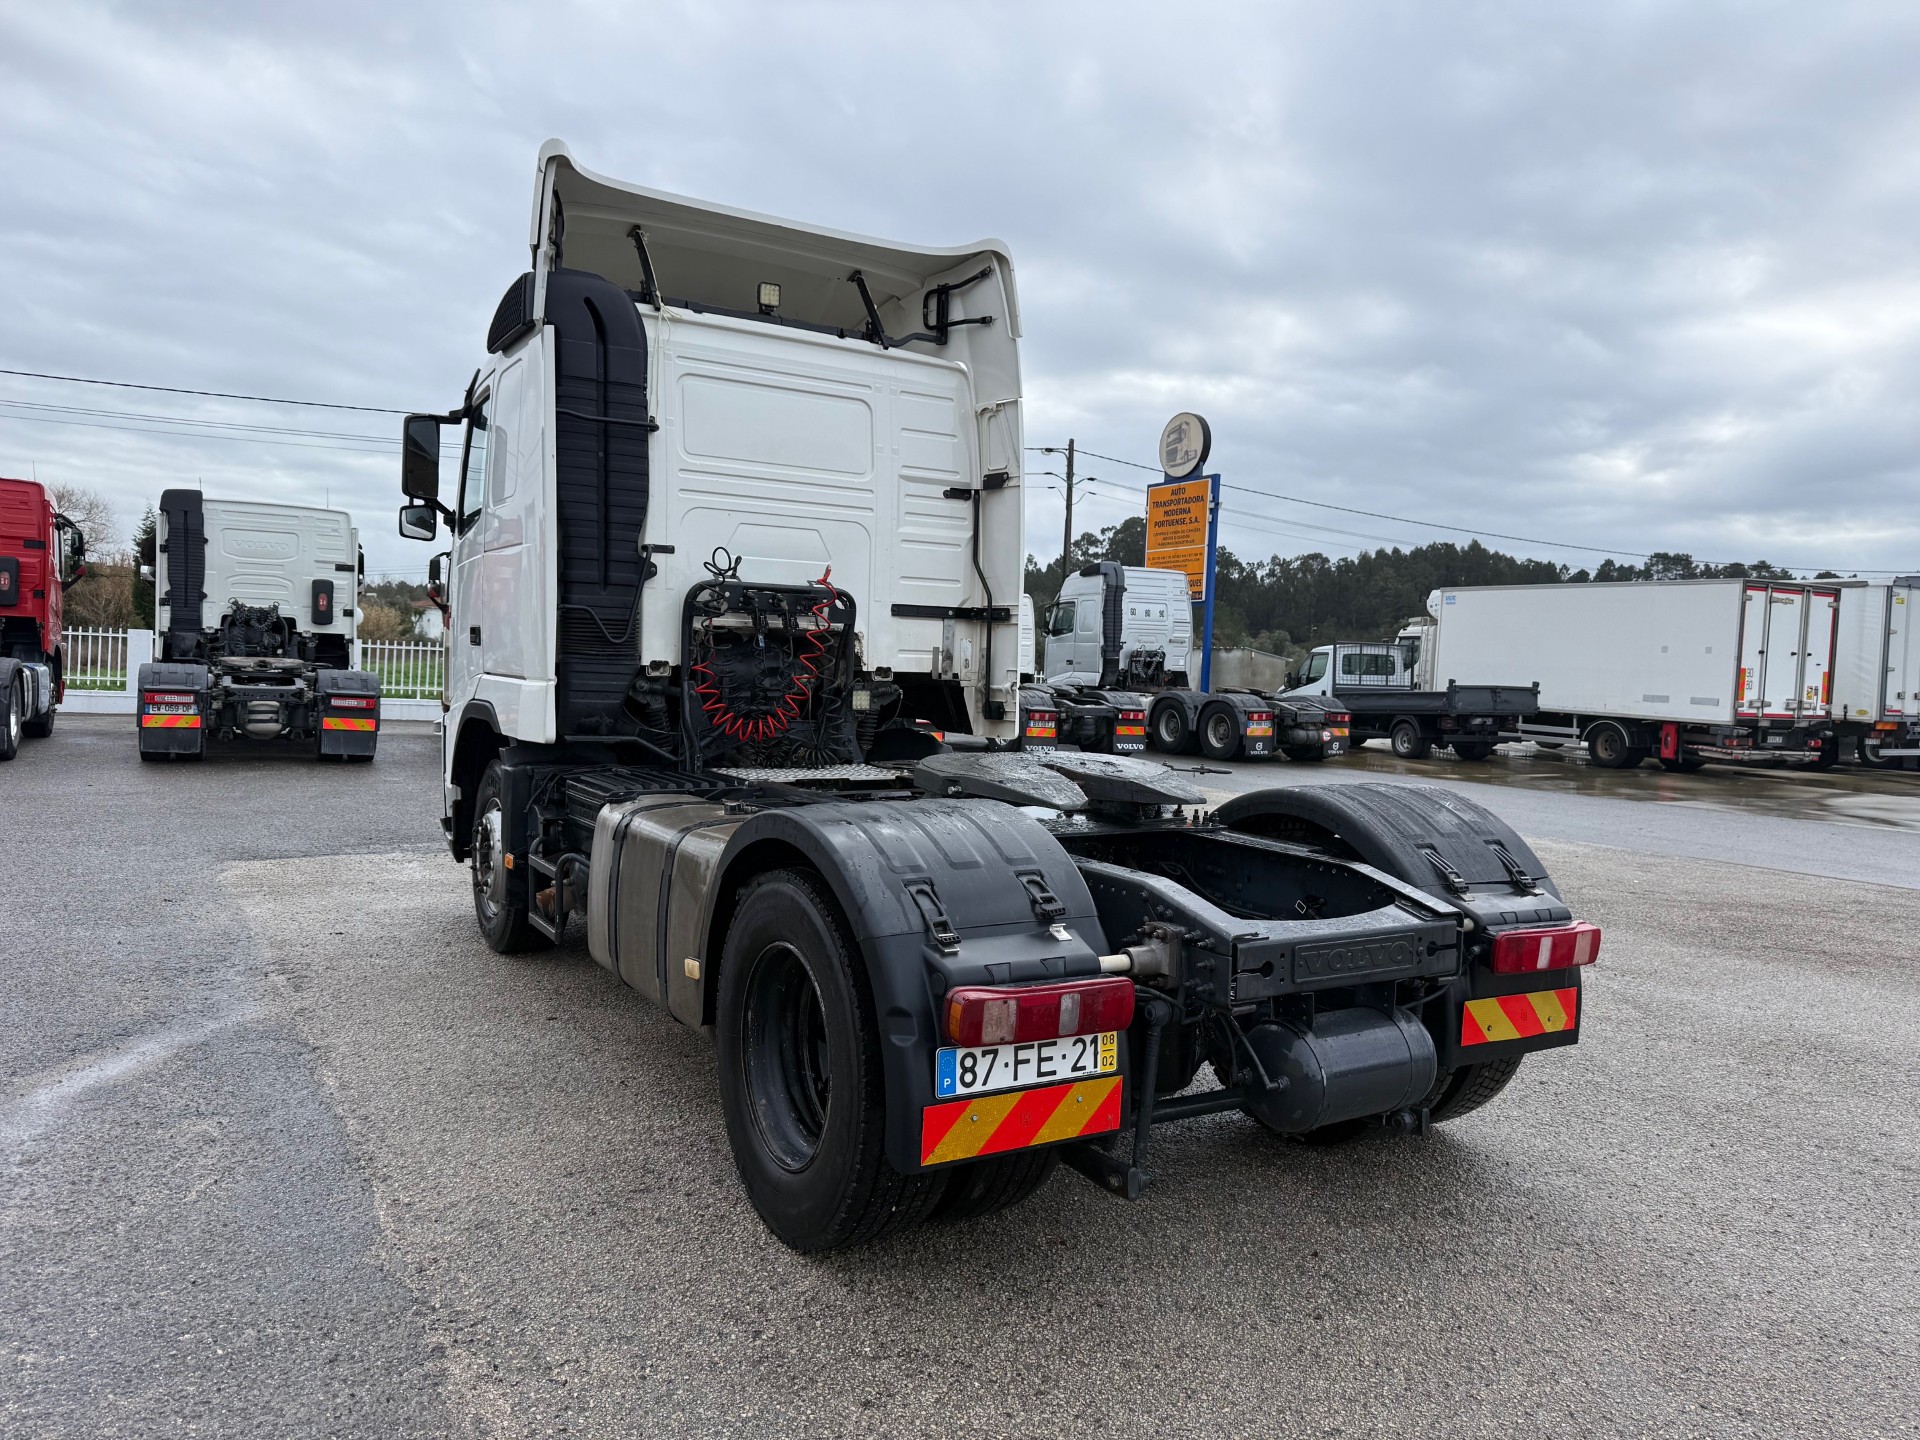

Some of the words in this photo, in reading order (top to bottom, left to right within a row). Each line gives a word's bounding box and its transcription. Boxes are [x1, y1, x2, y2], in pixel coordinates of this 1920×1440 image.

[1170, 487, 1186, 496] AUTO
[1152, 495, 1204, 509] TRANSPORTADORA
[1163, 507, 1191, 518] MODERNA
[1154, 517, 1188, 528] PORTUENSE,
[1188, 516, 1200, 524] S.A.
[231, 540, 289, 551] VOLVO
[1746, 668, 1754, 678] 90
[152, 704, 192, 712] EW-059-DP
[1300, 940, 1411, 974] VOLVO
[1102, 1034, 1114, 1046] 08
[944, 1078, 950, 1088] P
[1102, 1054, 1114, 1066] 02
